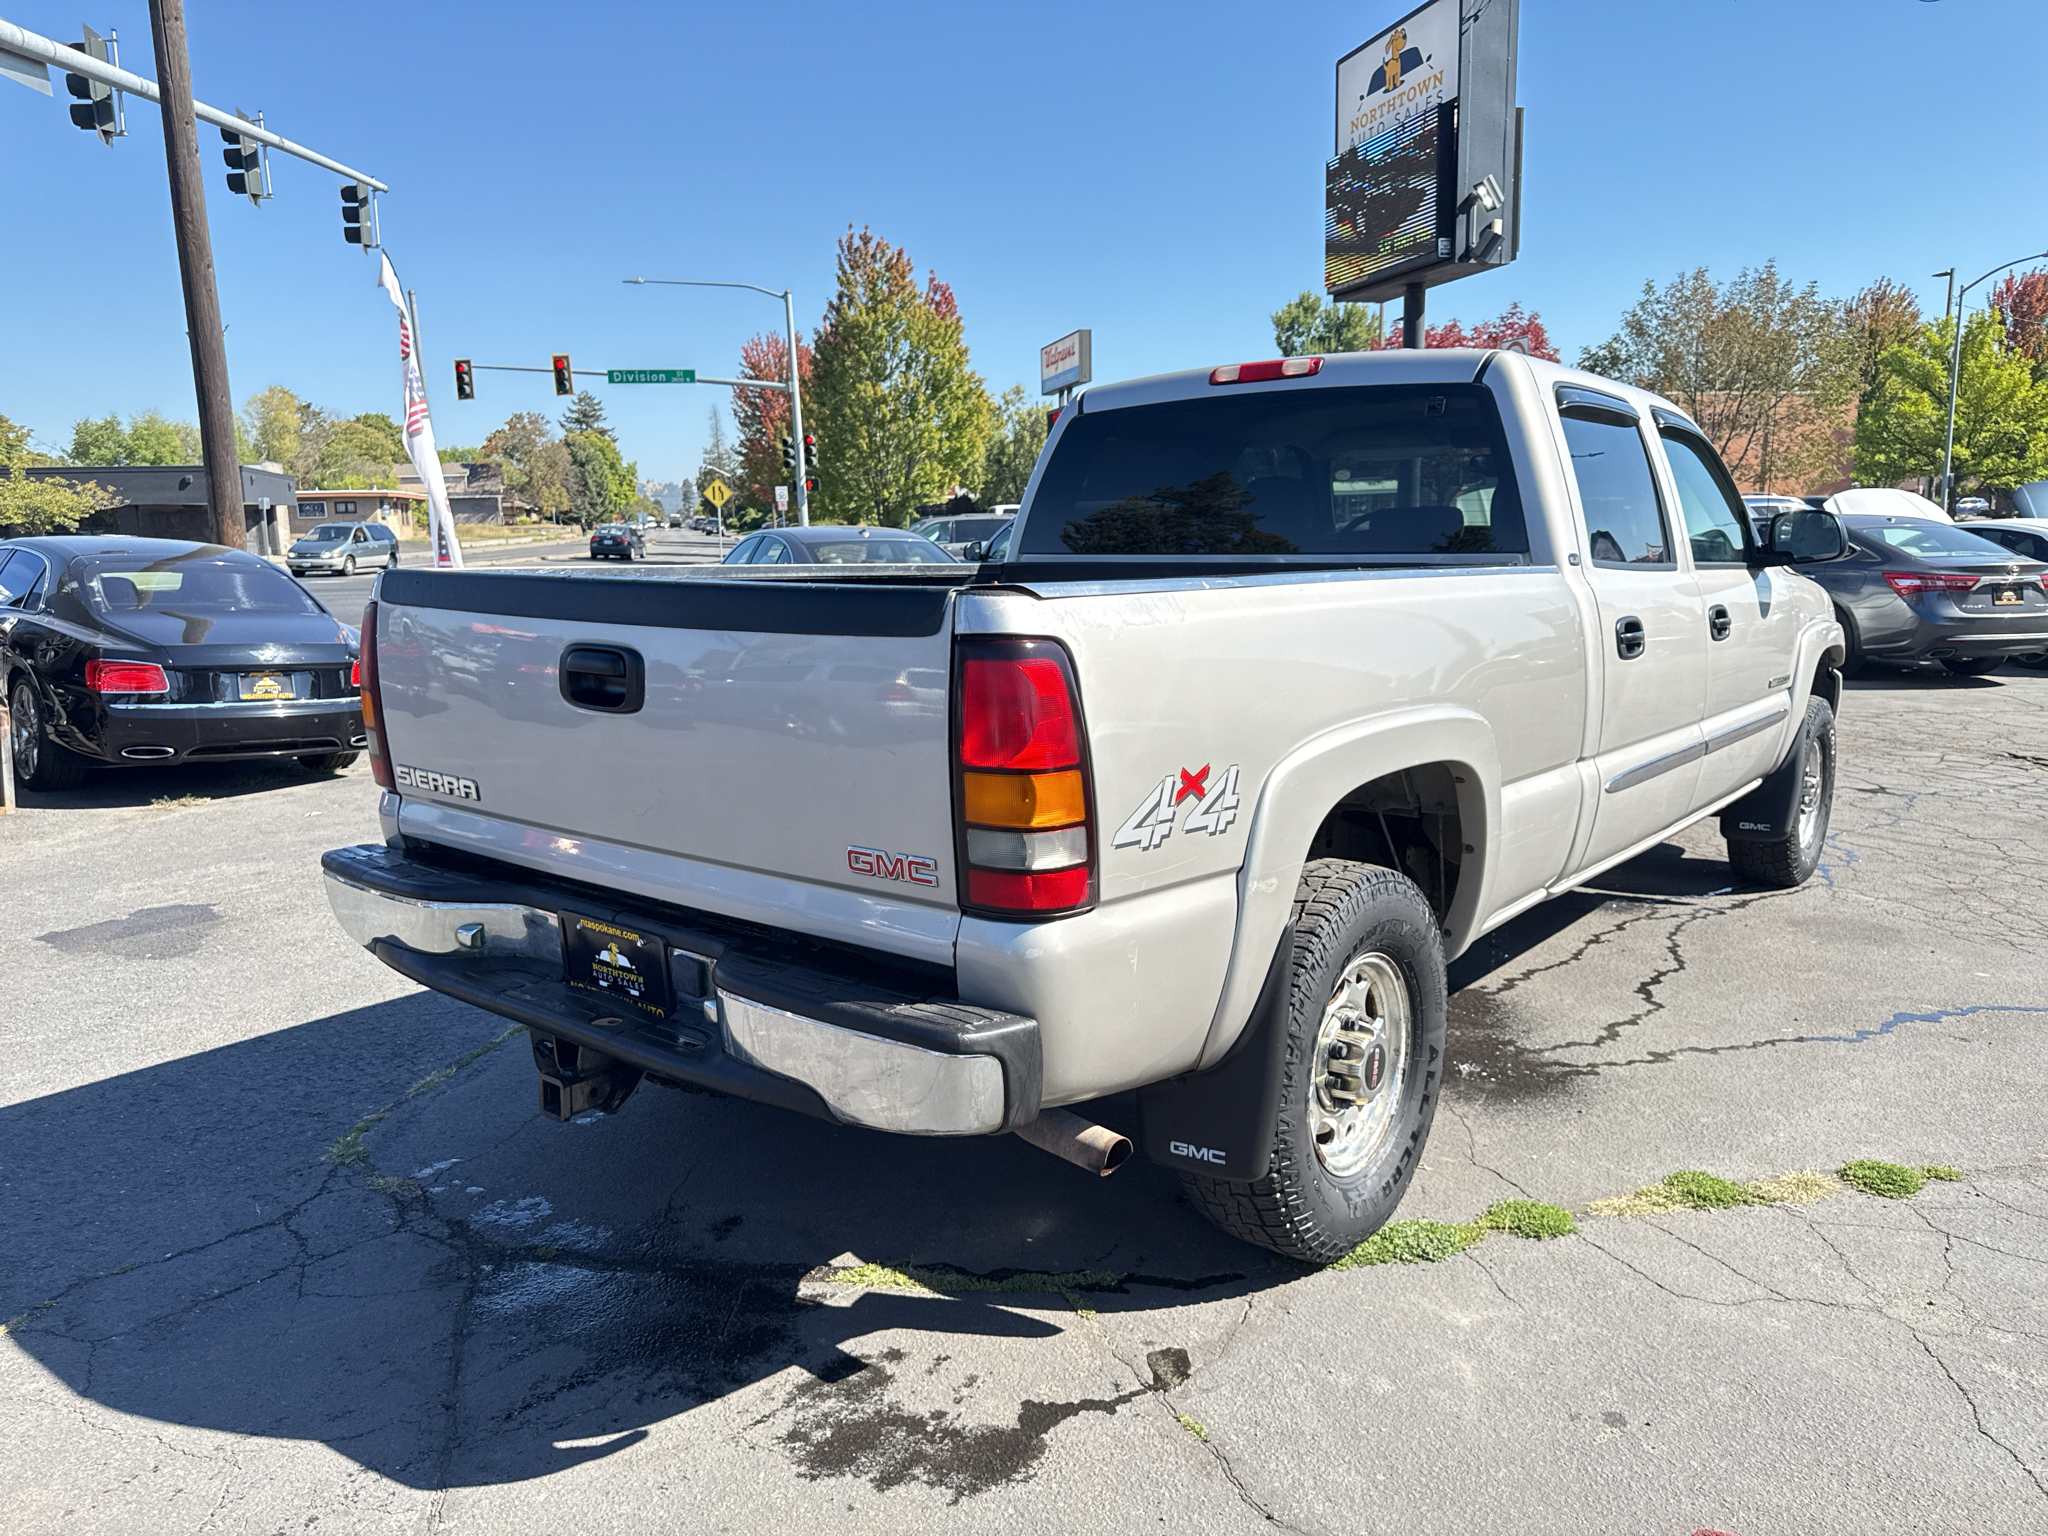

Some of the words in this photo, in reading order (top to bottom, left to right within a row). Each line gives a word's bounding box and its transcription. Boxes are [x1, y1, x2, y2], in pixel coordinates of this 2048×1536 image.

[1350, 69, 1444, 134] NORTHTOWN
[1350, 121, 1385, 149] AUTO
[1394, 89, 1443, 123] SALES
[613, 371, 666, 382] Division
[396, 764, 481, 801] SIERRA
[1739, 822, 1771, 831] GMC
[846, 845, 938, 888] GMC
[580, 919, 640, 941] ntaspokane.com
[592, 962, 643, 984] NORTHTOWN
[592, 970, 613, 982] AUTO
[617, 977, 645, 992] SALES
[1170, 1140, 1226, 1165] GMC
